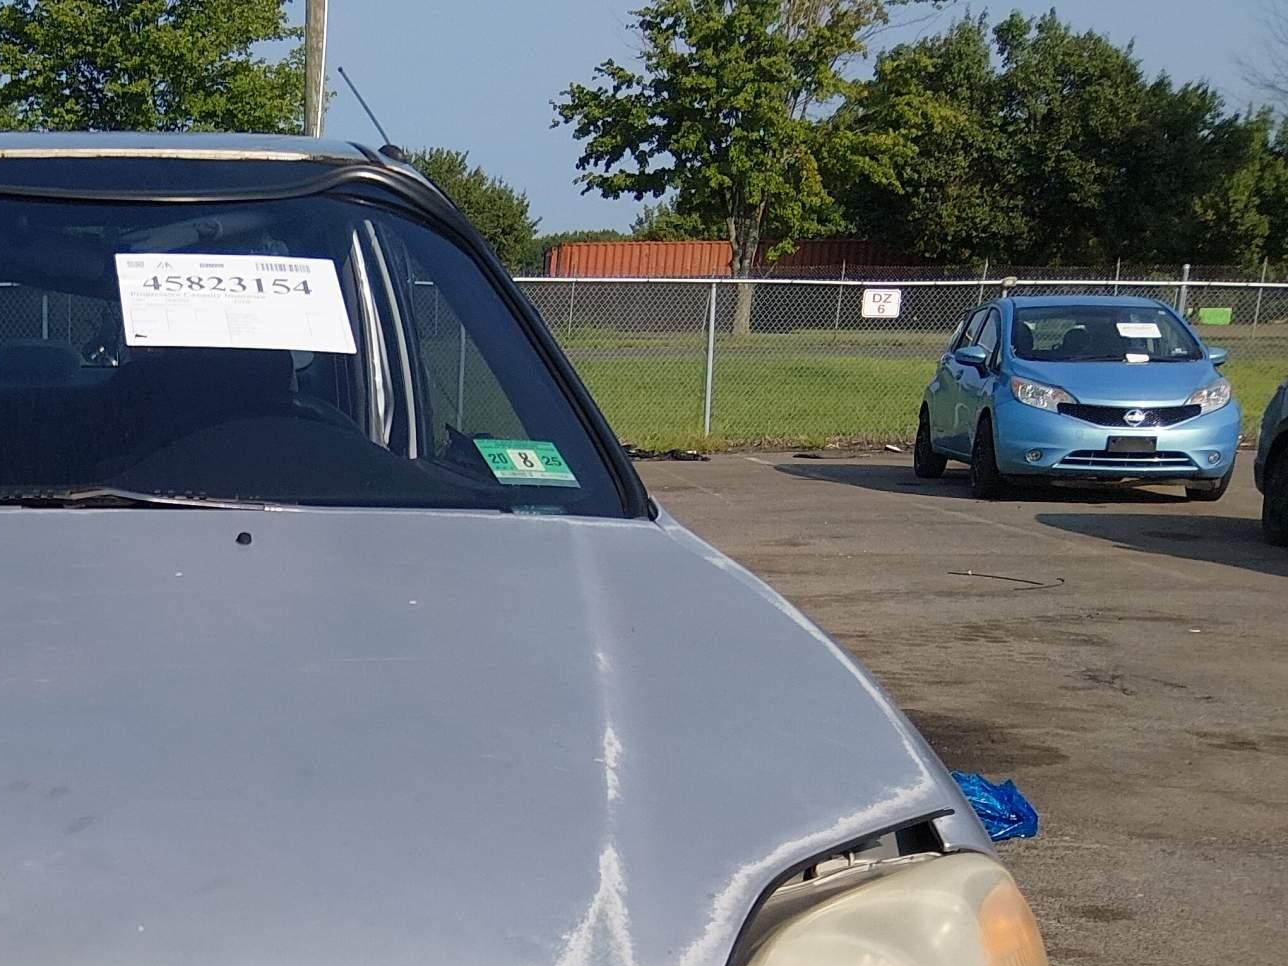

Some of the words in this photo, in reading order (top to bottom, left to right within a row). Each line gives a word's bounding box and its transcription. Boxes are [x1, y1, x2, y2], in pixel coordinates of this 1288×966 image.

[142, 275, 313, 295] 45823154
[872, 293, 892, 304] DZ
[877, 304, 886, 314] 6
[488, 452, 508, 464] 20
[518, 452, 535, 468] 8
[541, 455, 562, 467] 25
